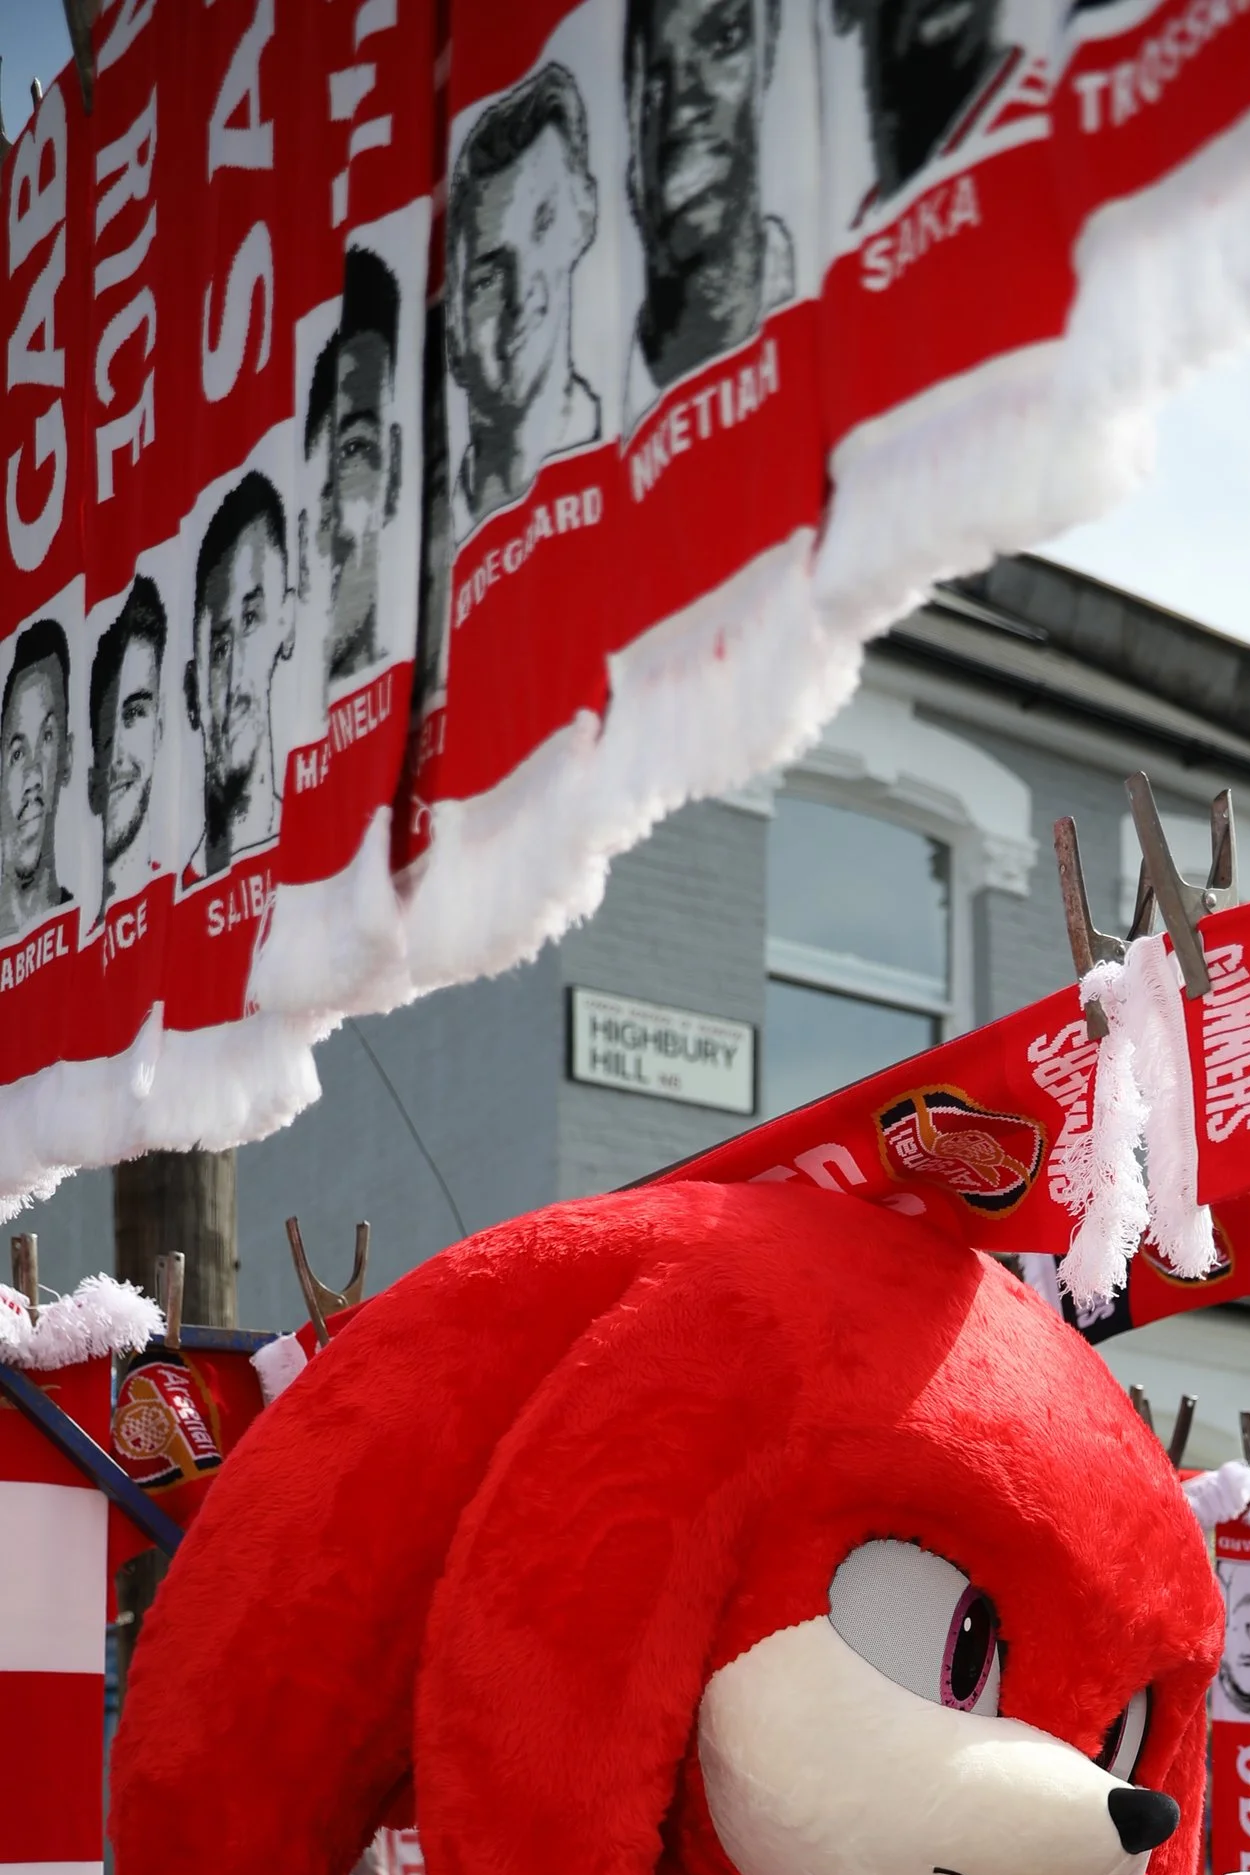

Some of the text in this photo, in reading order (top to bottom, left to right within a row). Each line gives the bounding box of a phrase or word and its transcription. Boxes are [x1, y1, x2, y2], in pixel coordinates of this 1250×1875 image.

[860, 175, 982, 291] SAKA
[630, 338, 780, 501] NKETIAH
[589, 1014, 738, 1071] HIGHBURY
[589, 1047, 651, 1085] HILL
[157, 1368, 217, 1450] Arsenal
